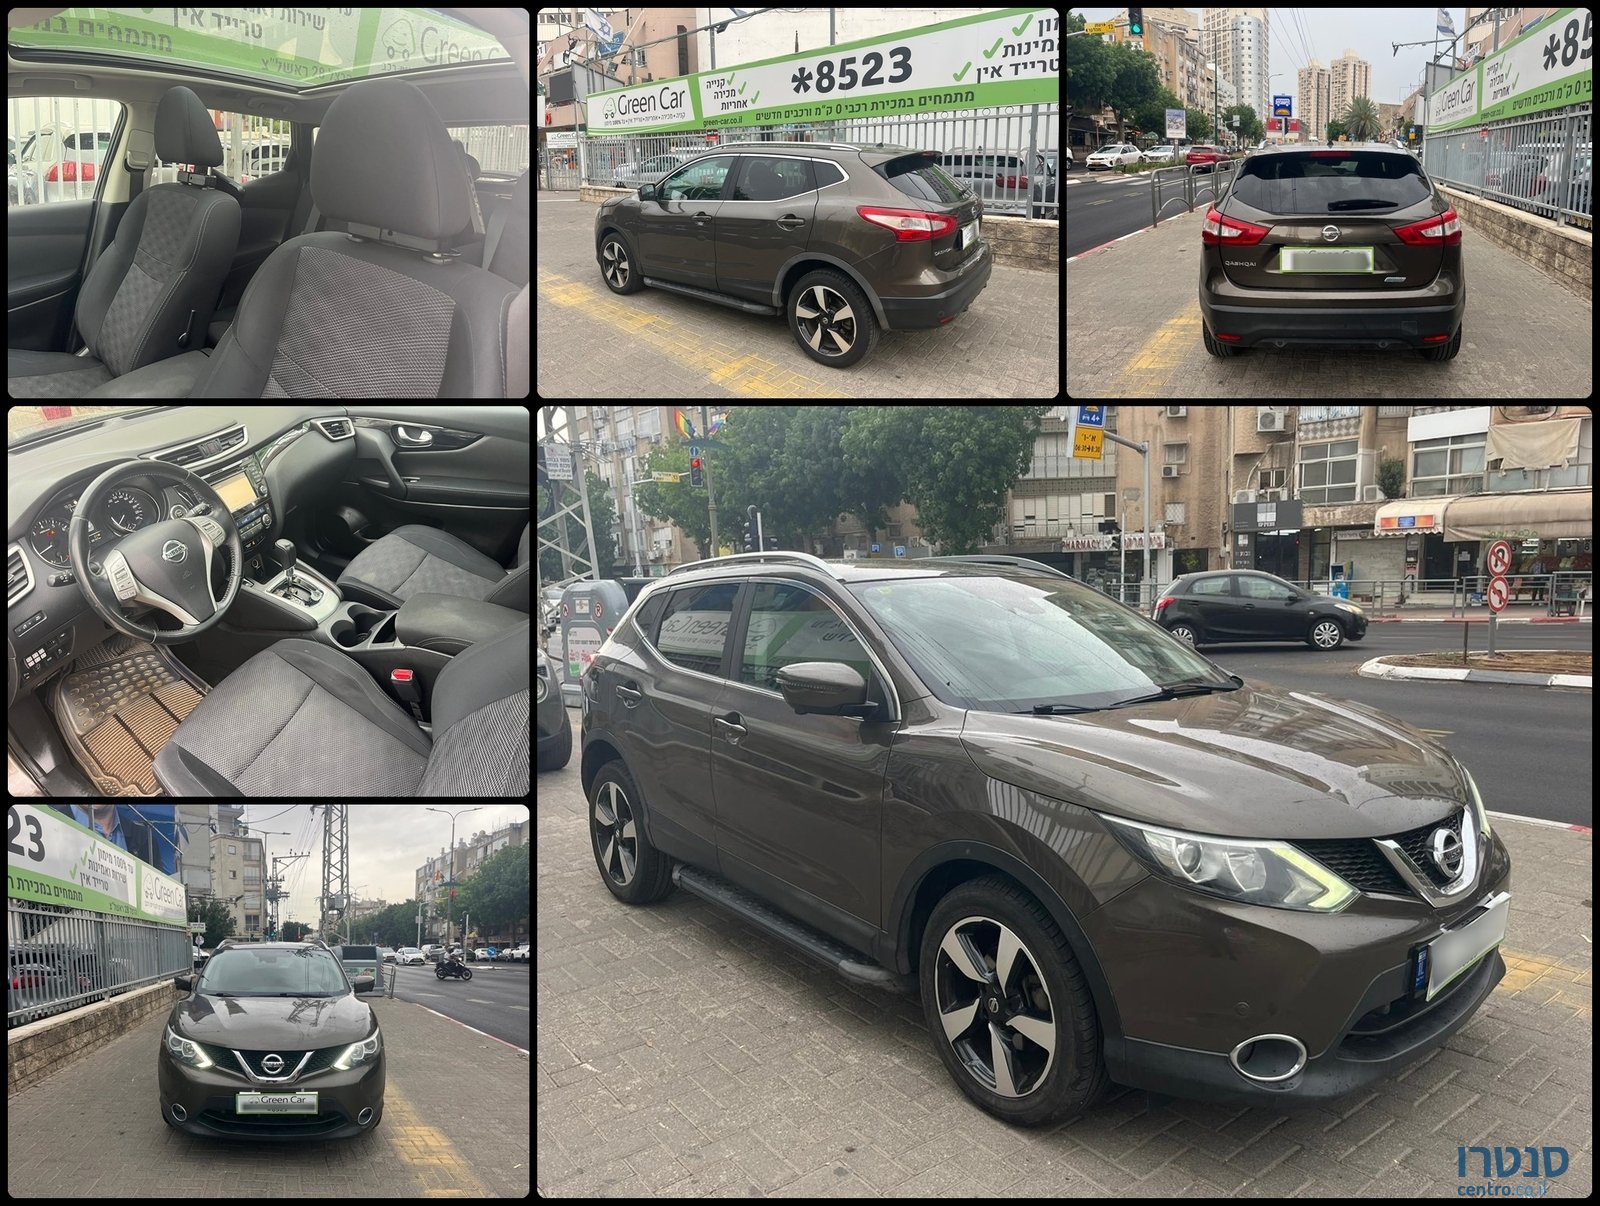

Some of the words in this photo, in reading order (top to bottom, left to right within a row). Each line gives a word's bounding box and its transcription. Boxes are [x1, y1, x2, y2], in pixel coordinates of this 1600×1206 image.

[212, 12, 263, 40] טרייד
[78, 18, 173, 52] מתמחים
[1002, 37, 1059, 58] מינות
[976, 64, 1003, 84] אין
[1009, 58, 1059, 76] טרייד
[706, 78, 726, 90] קנייה
[617, 94, 656, 116] Green
[659, 87, 686, 111] Car
[713, 88, 736, 100] מכירה
[918, 90, 975, 107] מתמחים
[1441, 88, 1460, 113] Green
[1461, 78, 1476, 104] Car
[1532, 90, 1555, 106] ורכבים
[720, 99, 748, 112] אחריות
[835, 103, 842, 115] 0
[845, 102, 868, 114] רכבי
[870, 96, 915, 111] במכירת
[755, 110, 782, 122] חדשים
[784, 107, 812, 120] ורכבים
[702, 116, 743, 128] green-car.co.il
[1062, 537, 1101, 550] PHARMACY
[16, 876, 53, 897] במכירת
[79, 871, 91, 888] אין
[92, 877, 109, 892] טרייד
[53, 886, 83, 903] מתמחים
[154, 875, 175, 905] Green
[260, 1095, 289, 1104] Green
[290, 1095, 306, 1104] Car
